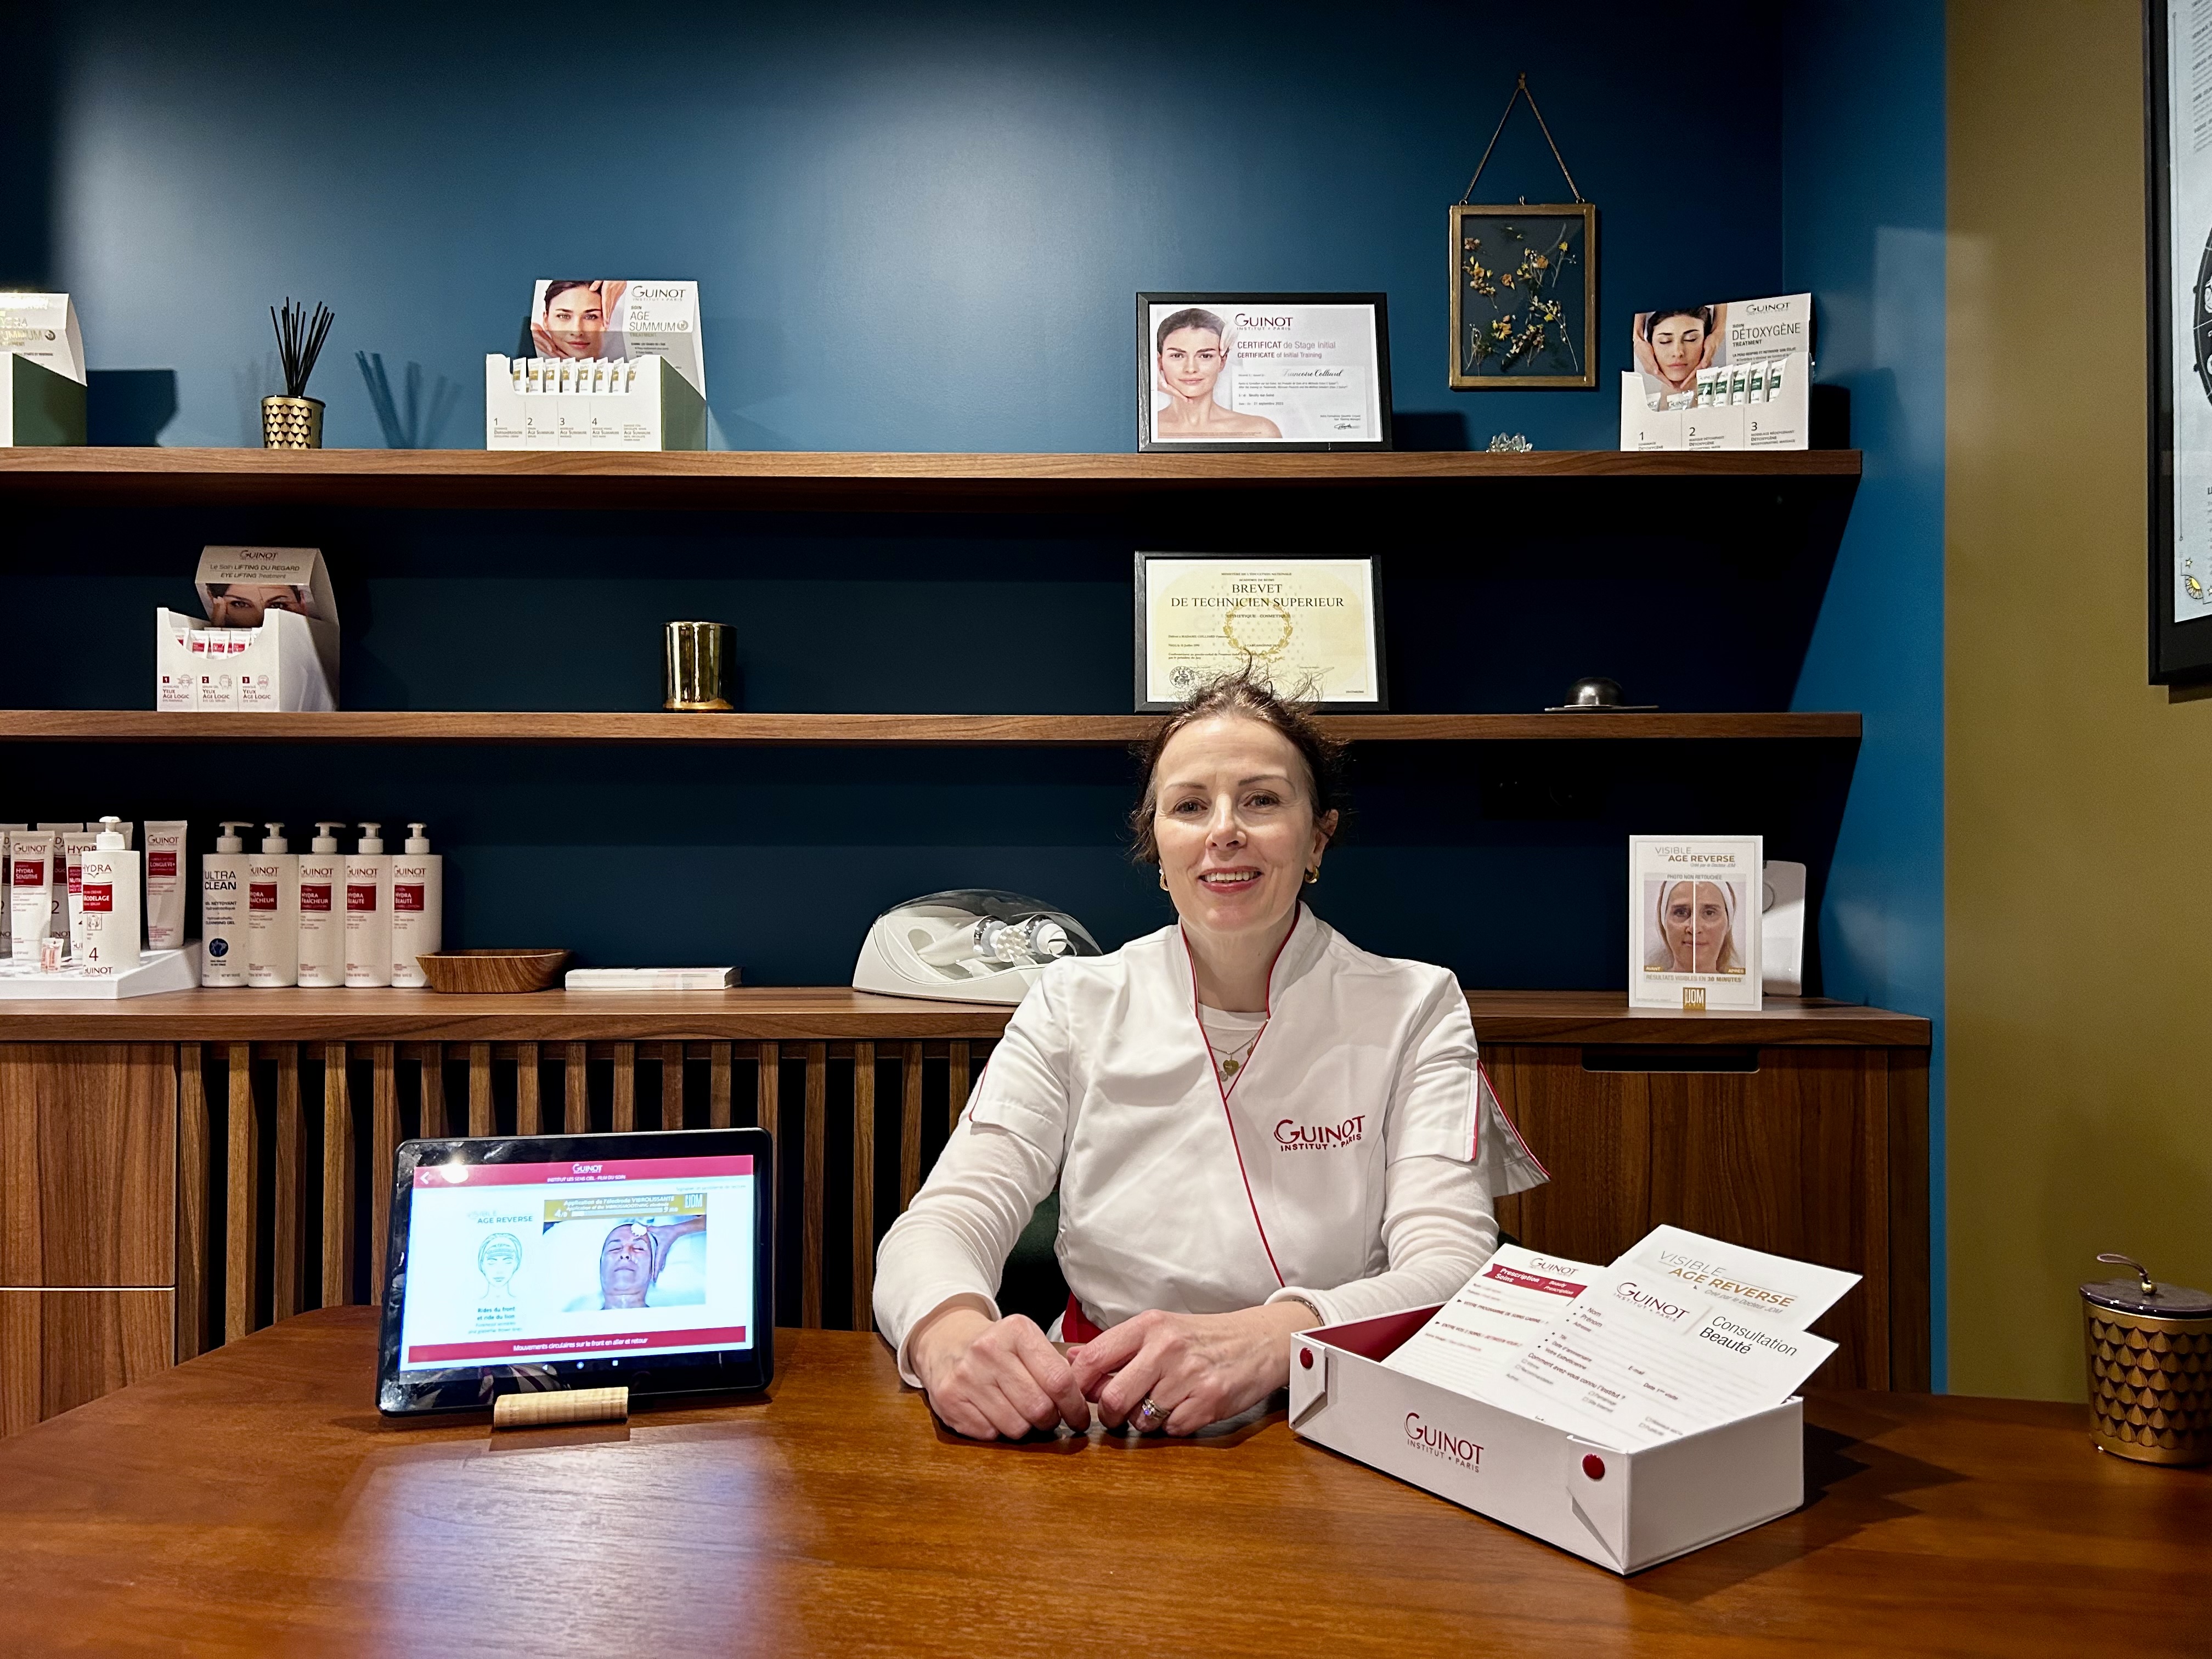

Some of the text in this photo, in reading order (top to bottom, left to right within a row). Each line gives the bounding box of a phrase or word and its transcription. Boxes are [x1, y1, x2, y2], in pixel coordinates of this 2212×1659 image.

[631, 285, 686, 298] GUINOT
[1746, 302, 1791, 313] GUINOT
[630, 311, 650, 320] AGE
[1234, 313, 1293, 326] GUINOT
[629, 321, 675, 331] SUMMUM
[1733, 323, 1801, 341] DÉTOXYGÈNE
[1295, 341, 1316, 350] Stage
[1318, 341, 1336, 349] Initial
[560, 417, 565, 426] 3
[1751, 422, 1757, 431] 3
[1639, 432, 1644, 441] 1
[1689, 427, 1695, 436] 2
[240, 550, 278, 559] GUINOT
[1232, 584, 1282, 593] BREVET
[1171, 597, 1345, 607] DE TECHNICIEN SUPERIEUR
[148, 834, 179, 844] GUINOT
[13, 843, 48, 853] GUINOT
[205, 870, 236, 879] ULTRA
[300, 865, 334, 876] GUINOT
[205, 881, 236, 890] CLEAN
[52, 900, 60, 914] 2
[89, 947, 99, 961] 4
[1274, 1115, 1365, 1144] GUINOT
[1341, 1133, 1362, 1148] PARIS
[572, 1164, 603, 1172] GUINOT
[1530, 1258, 1579, 1275] GUINOT
[1661, 1251, 1726, 1277] VISIBLE
[1494, 1273, 1514, 1283] Soins
[1500, 1268, 1540, 1283] Prescription
[1544, 1285, 1574, 1295] Prescription
[1668, 1268, 1795, 1307] AGE REVERSE
[1614, 1293, 1646, 1309] INSTITUT
[1617, 1282, 1690, 1318] GUINOT
[1739, 1299, 1766, 1310] Docteur
[1588, 1307, 1601, 1317] Nom
[1581, 1314, 1602, 1327] Prénom
[1699, 1327, 1752, 1354] Beauté
[1713, 1316, 1797, 1356] Consultation
[1528, 1352, 1554, 1368] Comment
[1553, 1365, 1581, 1380] avez-vous
[1580, 1378, 1596, 1389] connu
[1404, 1412, 1484, 1465] GUINOT
[1407, 1439, 1479, 1473] INSTITUT PARIS
